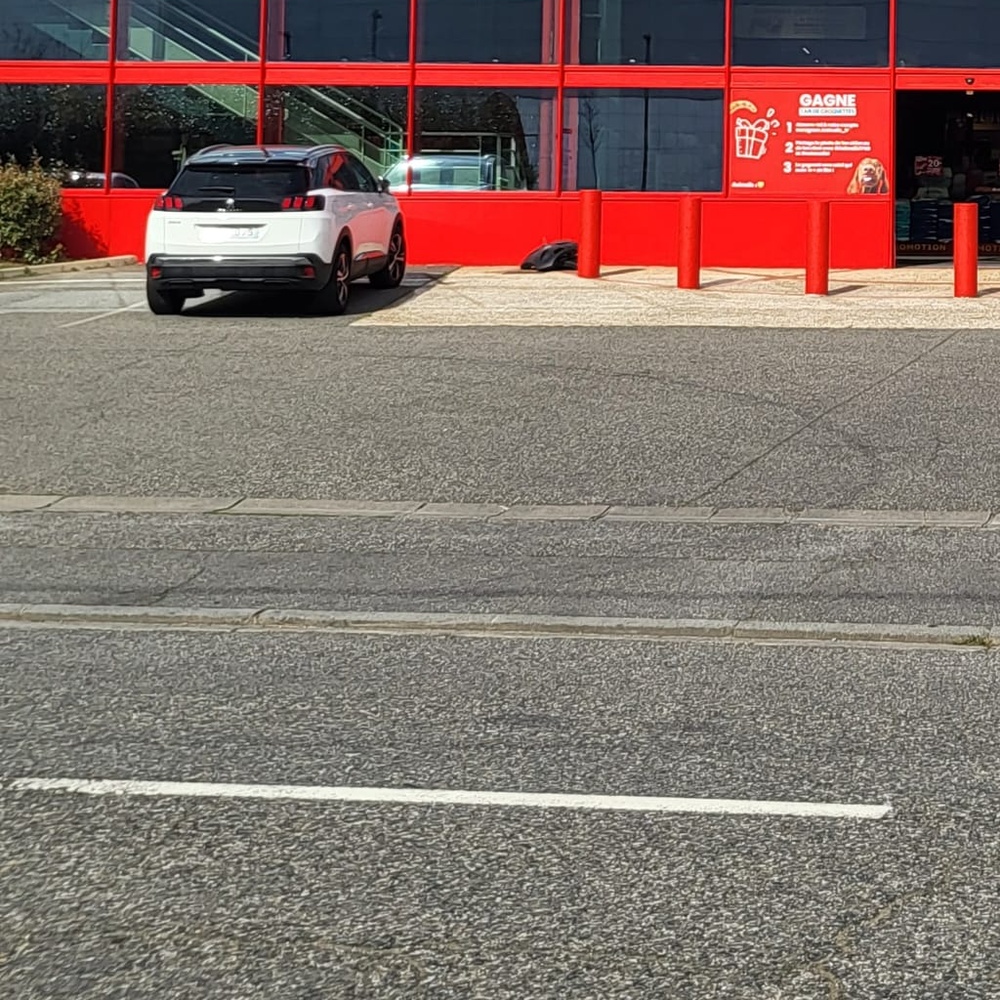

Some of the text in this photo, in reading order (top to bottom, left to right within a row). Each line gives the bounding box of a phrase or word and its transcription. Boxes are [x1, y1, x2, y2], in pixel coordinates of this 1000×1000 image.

[799, 93, 857, 107] GAGNE
[785, 121, 793, 134] 1
[784, 141, 794, 154] 2
[782, 161, 793, 173] 3
